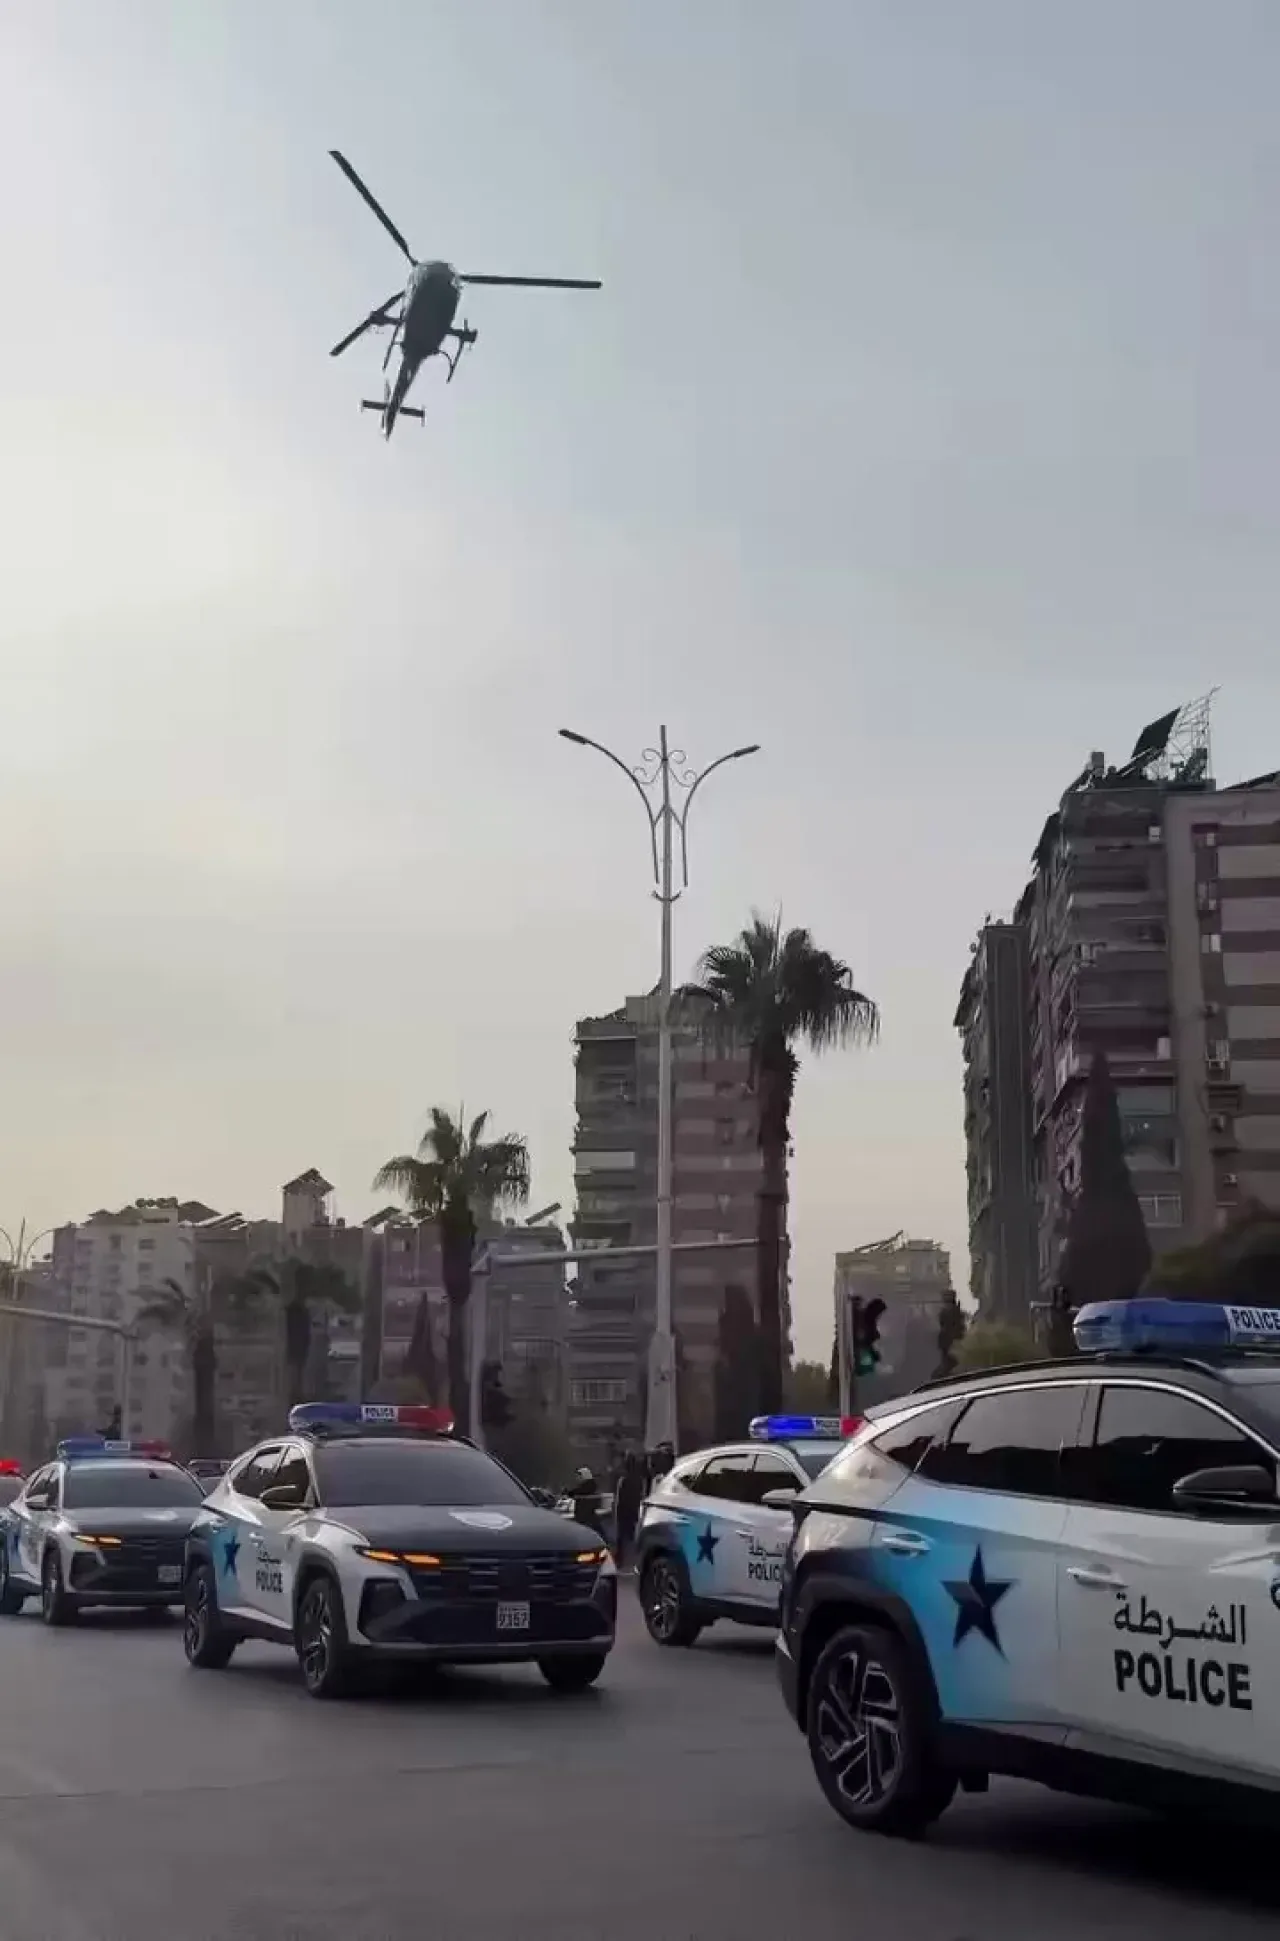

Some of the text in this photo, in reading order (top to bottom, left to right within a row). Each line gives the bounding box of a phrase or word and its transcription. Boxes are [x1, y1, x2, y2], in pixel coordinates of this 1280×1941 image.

[1231, 1308, 1280, 1330] POLICE
[365, 1407, 395, 1418] POLICE
[748, 1562, 781, 1581] POLIC
[1114, 1592, 1247, 1650] الشرطة
[1114, 1649, 1252, 1711] POLICE
